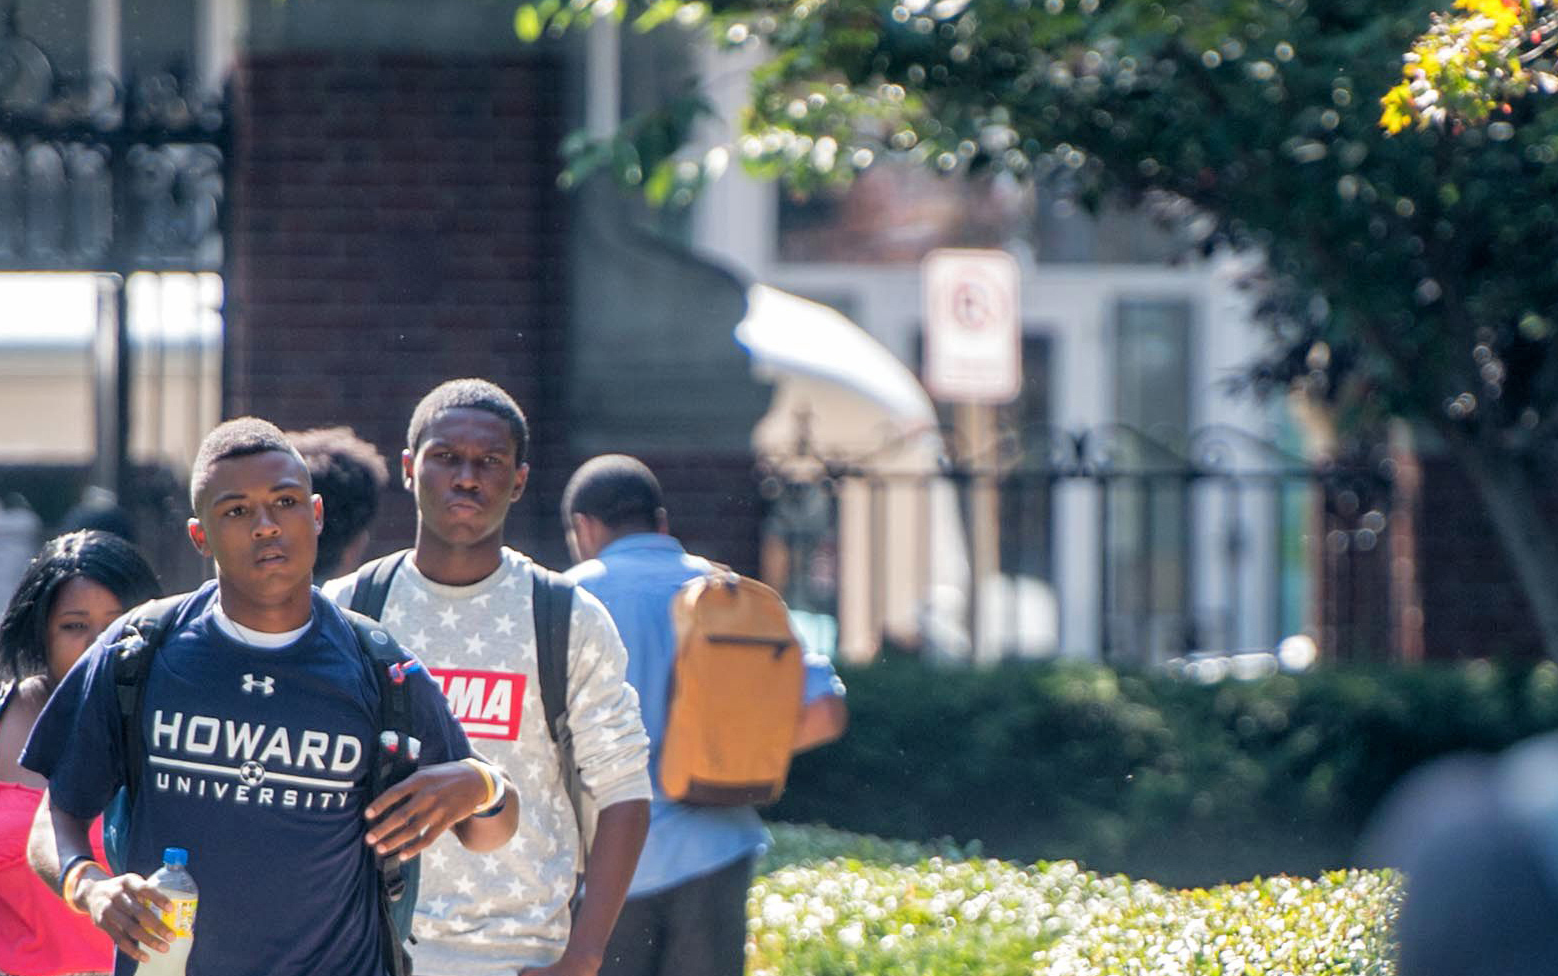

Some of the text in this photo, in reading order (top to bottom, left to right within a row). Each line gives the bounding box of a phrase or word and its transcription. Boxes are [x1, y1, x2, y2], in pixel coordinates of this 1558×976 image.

[433, 675, 512, 721] MA
[153, 710, 362, 772] HOWARD
[156, 772, 348, 808] UNIVERSITY
